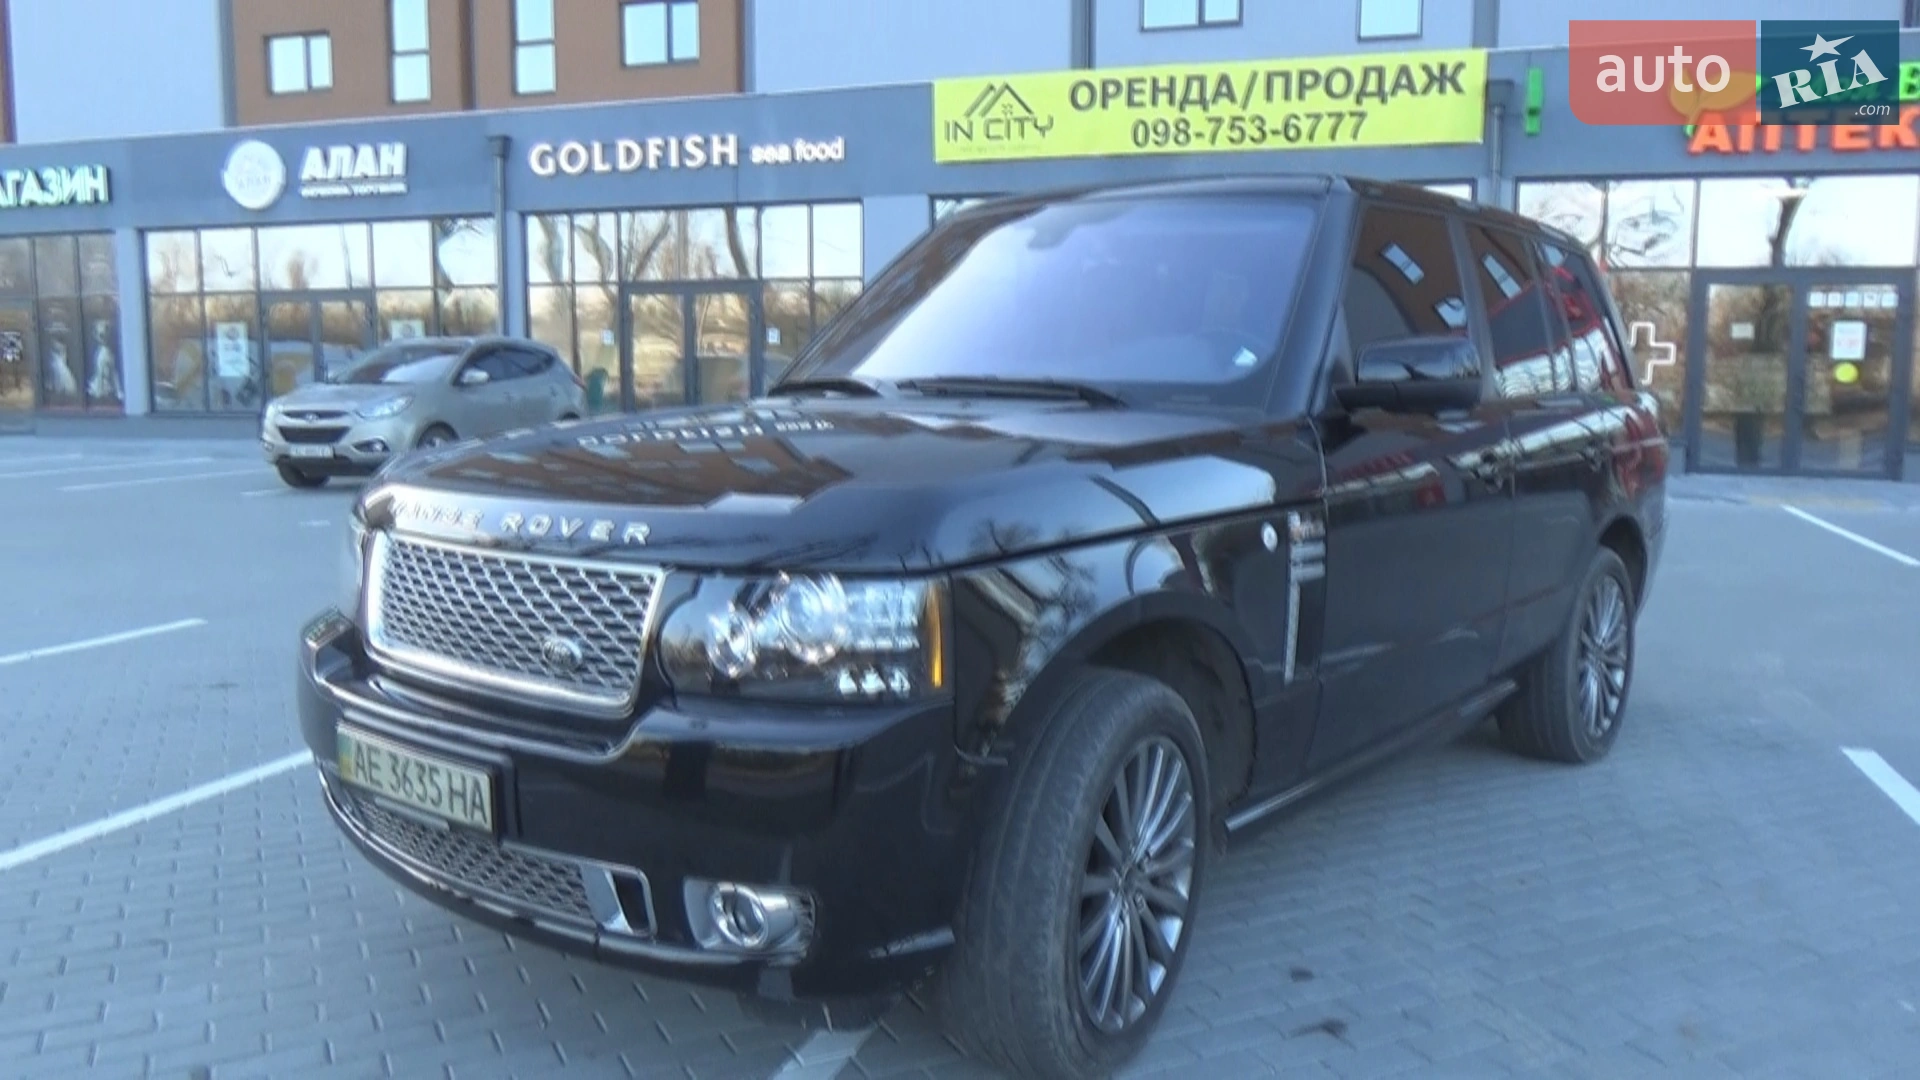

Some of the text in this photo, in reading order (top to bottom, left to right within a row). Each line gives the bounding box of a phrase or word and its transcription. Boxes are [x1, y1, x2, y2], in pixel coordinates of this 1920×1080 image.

[1070, 62, 1466, 112] ОРЕНДА/ПРОДАЖ
[944, 114, 1054, 143] IN CITY
[1131, 111, 1368, 149] 098-753-6777
[529, 133, 846, 176] GOLDFISH sea food
[502, 511, 651, 546] ROVER
[354, 742, 488, 825] AE 3635 HA
